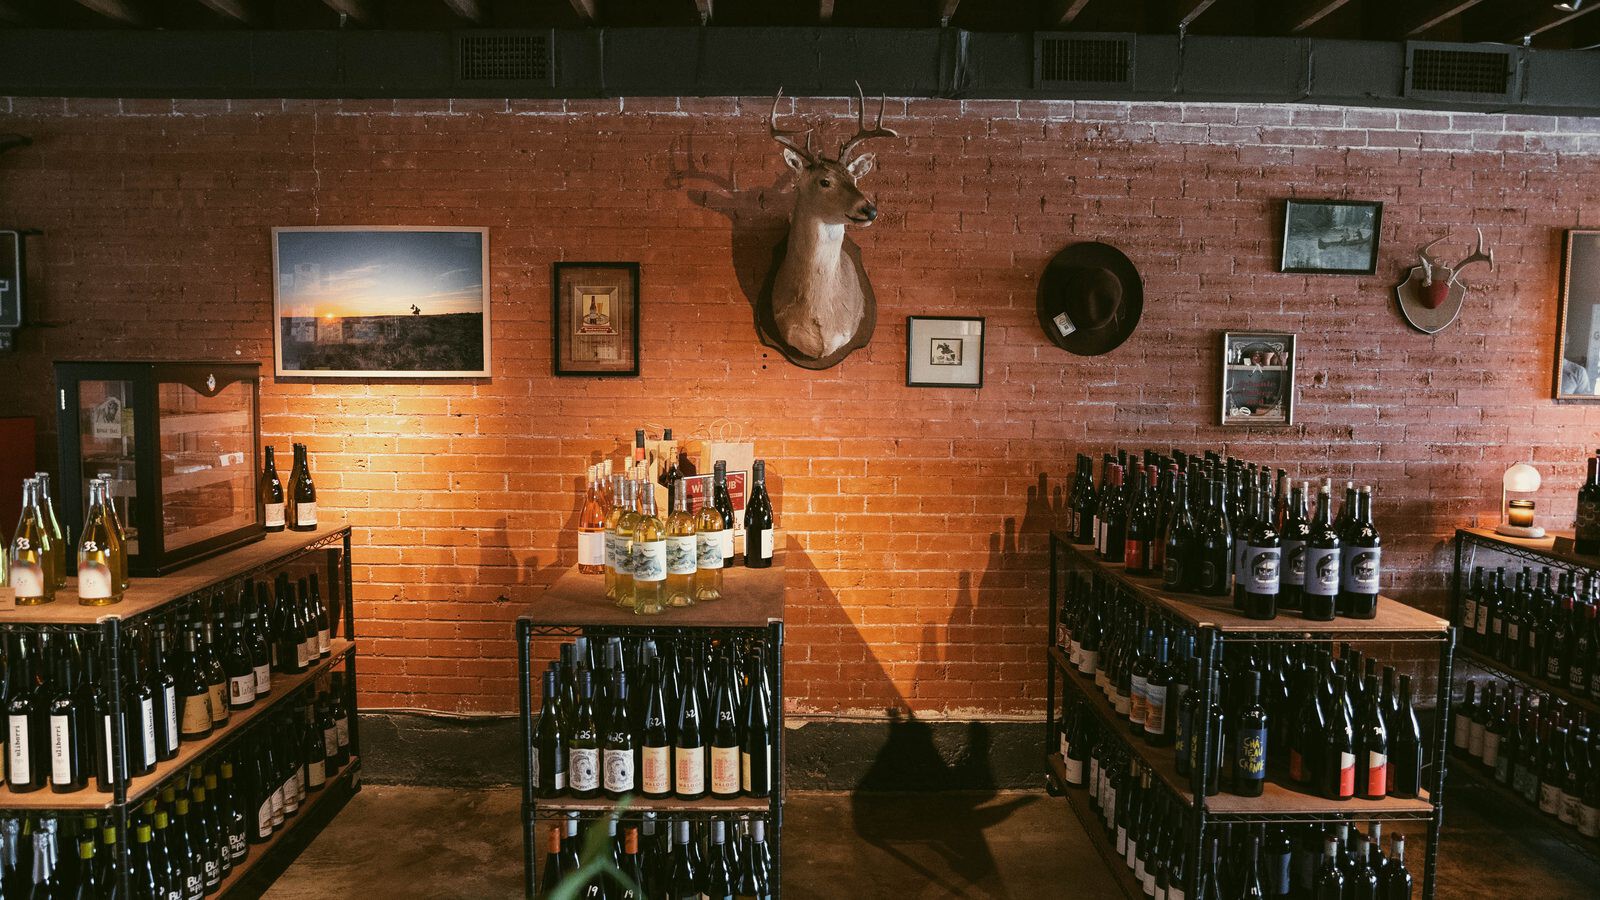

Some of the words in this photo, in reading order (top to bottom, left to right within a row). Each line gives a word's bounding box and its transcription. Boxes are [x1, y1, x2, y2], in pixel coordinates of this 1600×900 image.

[17, 537, 30, 550] 33
[84, 541, 98, 552] 33
[685, 709, 697, 719] 32
[721, 711, 733, 721] 32
[580, 731, 591, 740] 25
[588, 884, 599, 897] 19
[625, 889, 634, 899] 19
